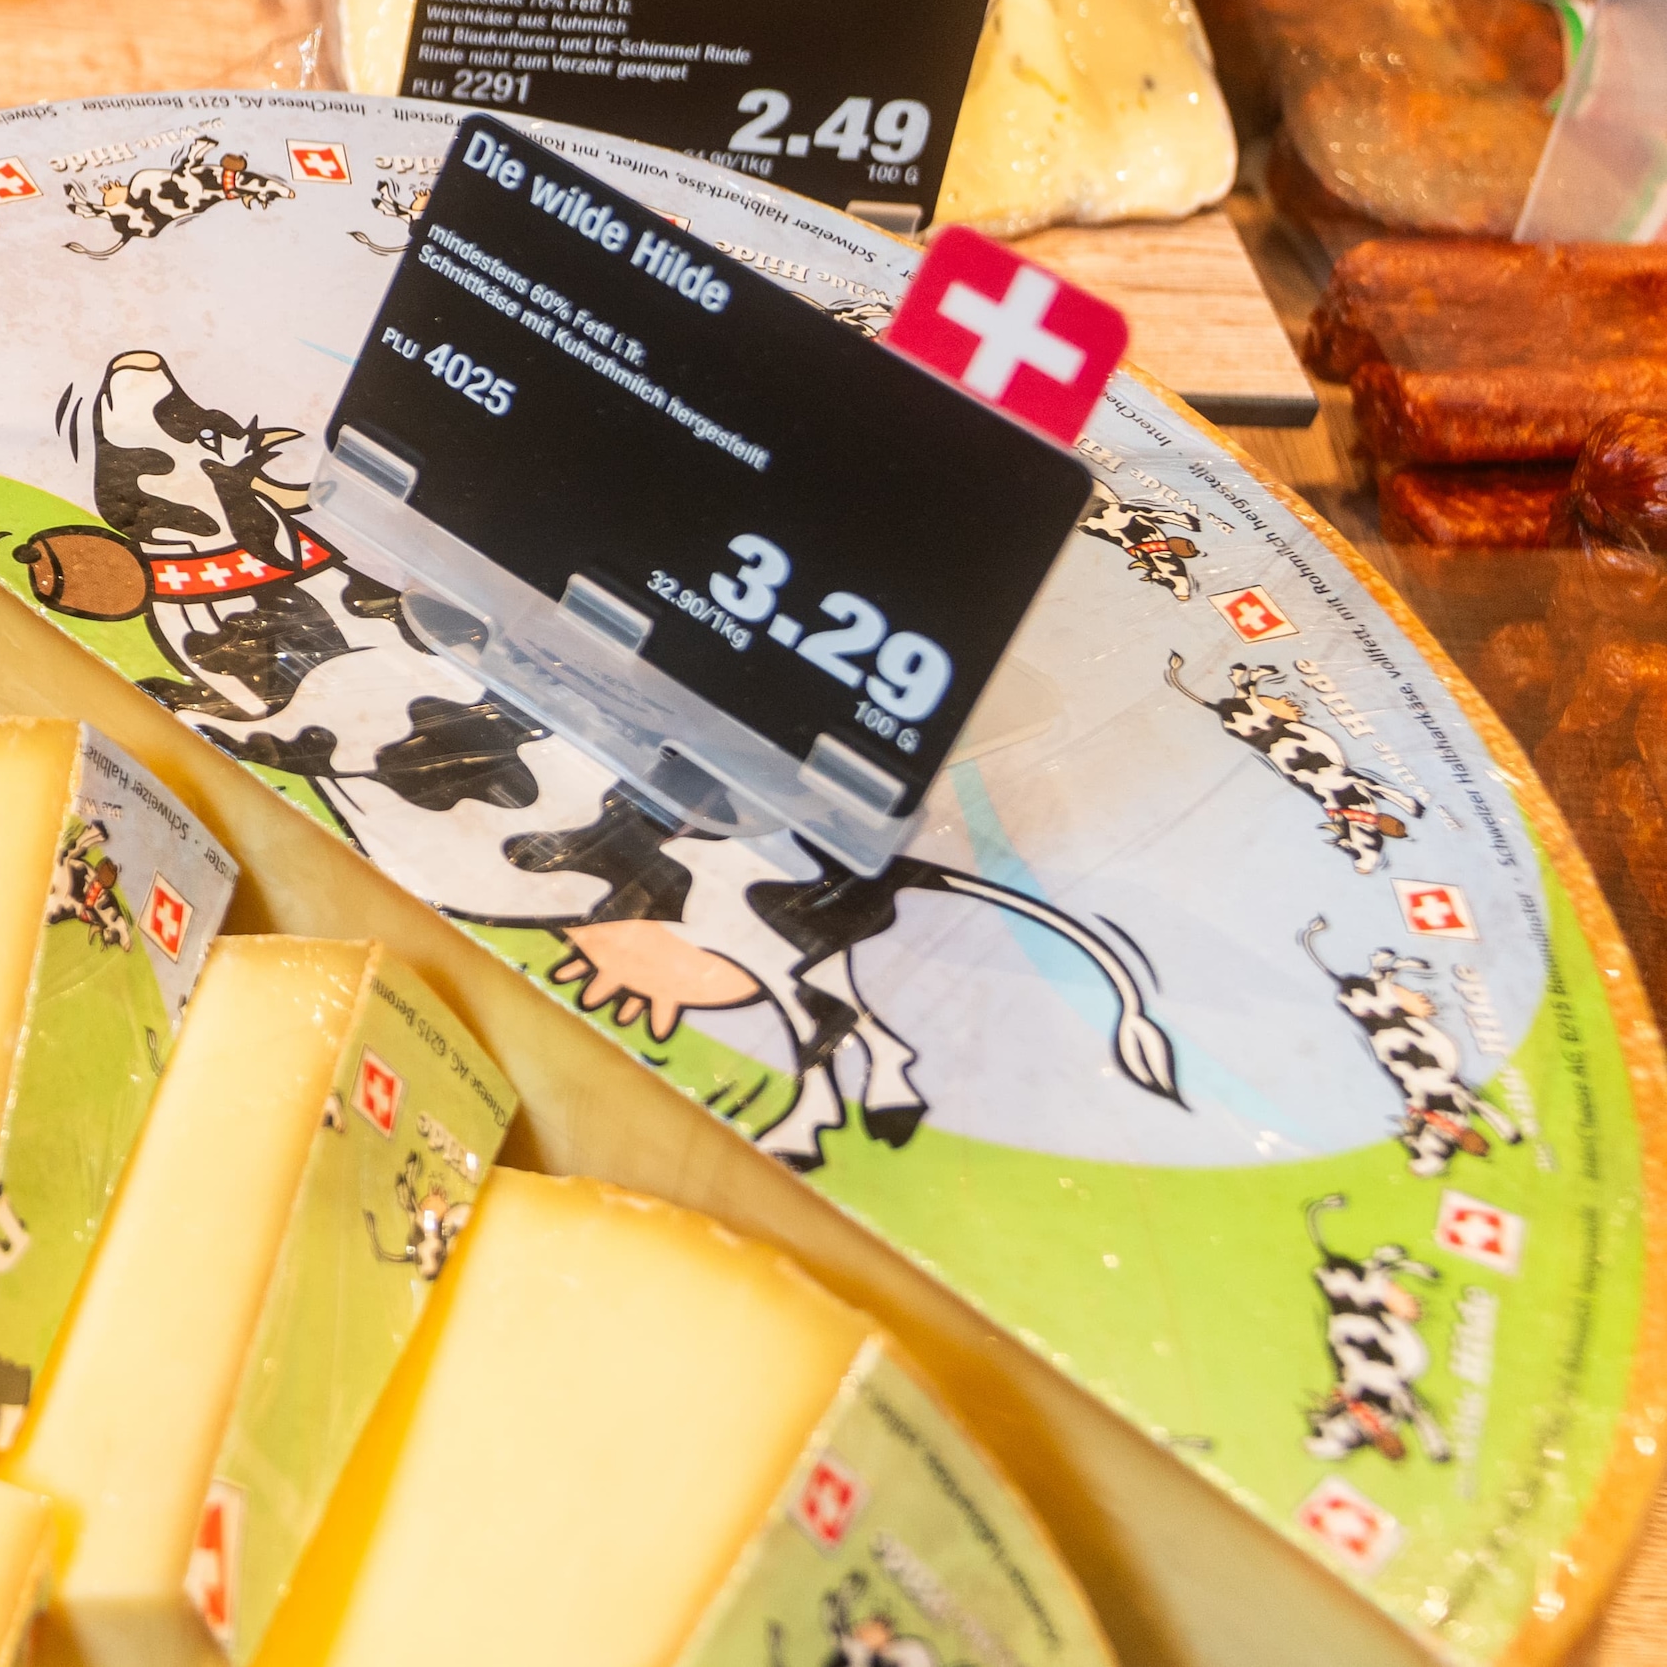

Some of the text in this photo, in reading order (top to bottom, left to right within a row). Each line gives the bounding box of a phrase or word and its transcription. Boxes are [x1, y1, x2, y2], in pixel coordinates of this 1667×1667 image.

[427, 5, 626, 33] Weichkäse aus Kuhmilch
[418, 44, 687, 80] Rinde nicht zum Verzehr geeignet
[422, 27, 750, 63] mit Blaukulturen und Ur-Schimmel Rinde
[79, 92, 185, 115] Beromünster
[187, 92, 230, 109] 6215
[233, 92, 263, 109] AG,
[268, 93, 368, 119] InterCheese
[412, 70, 529, 102] PLU 2291
[729, 88, 932, 165] 2.49
[51, 138, 139, 176] Hilde
[869, 164, 900, 182] 100
[464, 132, 728, 310] Die wilde Hilde
[567, 140, 879, 264] Schweizer Halbhartkäse, vollfett, mit
[708, 233, 813, 284] Hilde
[429, 225, 528, 293] mindestens
[530, 284, 571, 320] 60%
[573, 310, 613, 344] Fett
[382, 327, 514, 414] PLU 4025
[419, 238, 767, 468] Schnittkäse mit Kuhrohmilch hergestellt
[648, 571, 750, 649] 32.90/1kg
[707, 534, 952, 723] 3.29
[1181, 458, 1519, 875] Schweizer Halbhartkäse, vollfett, mit Rohmilch hergestellt
[1287, 656, 1379, 747] Hilde
[855, 702, 919, 752] 100 G
[124, 779, 195, 842] Schweizer
[411, 1015, 453, 1058] 6215
